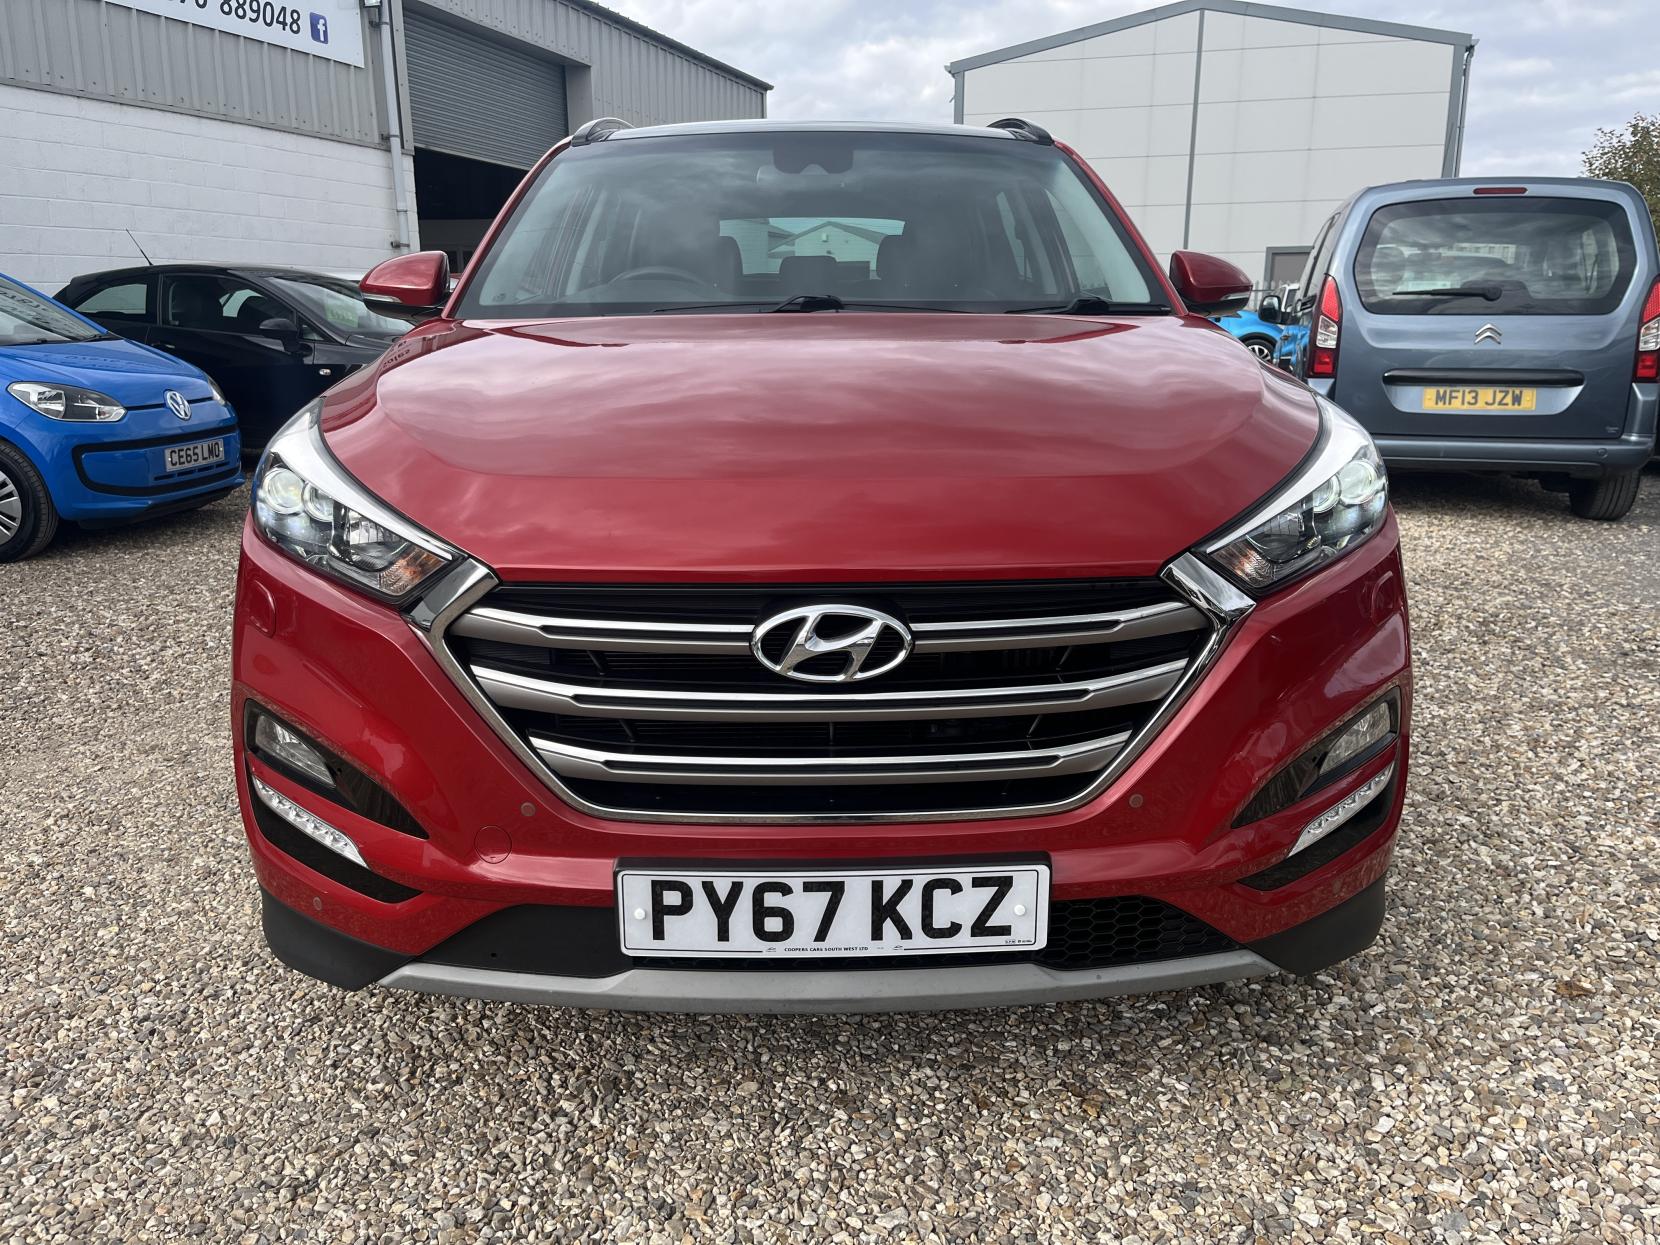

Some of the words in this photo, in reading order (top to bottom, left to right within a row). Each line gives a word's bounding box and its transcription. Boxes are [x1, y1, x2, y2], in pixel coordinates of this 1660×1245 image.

[220, 0, 301, 35] 889048
[1435, 389, 1479, 406] MF13
[1485, 389, 1523, 407] JZW
[170, 445, 199, 467] CE65
[202, 442, 220, 460] LMO
[651, 880, 845, 942] PY67
[871, 876, 1014, 941] KCZ
